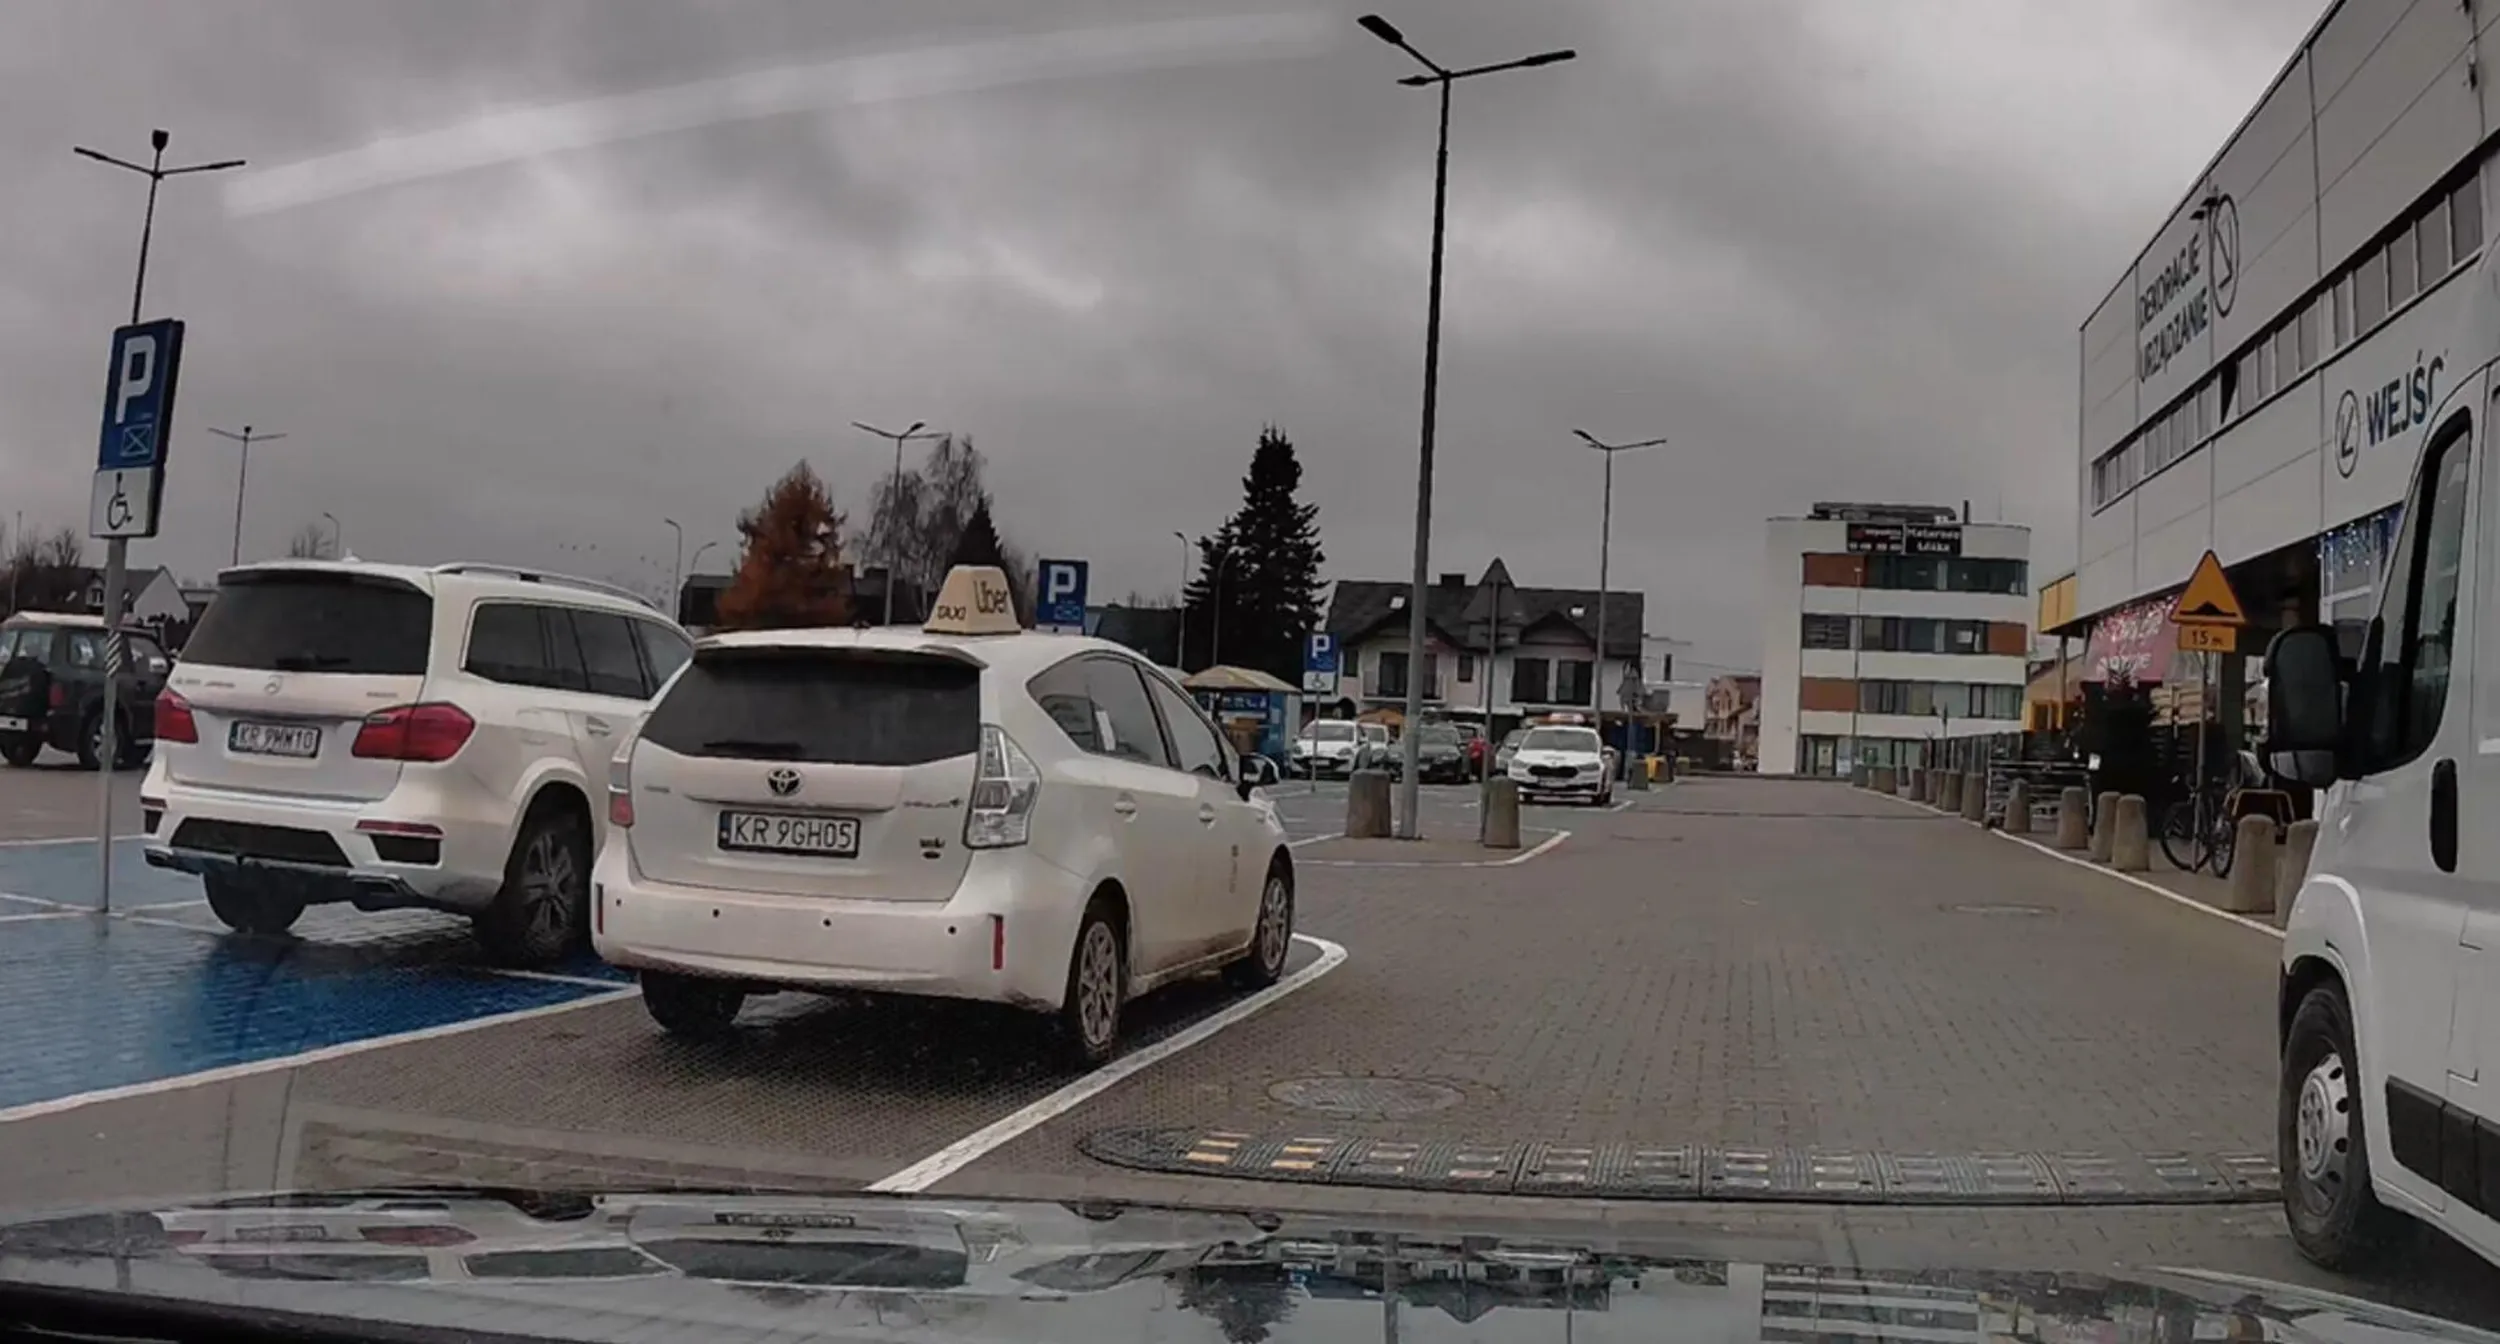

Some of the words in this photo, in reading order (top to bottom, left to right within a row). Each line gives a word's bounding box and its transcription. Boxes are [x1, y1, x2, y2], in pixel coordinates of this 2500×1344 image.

[115, 334, 157, 425] P
[2365, 348, 2448, 448] WEJŚC
[973, 580, 1009, 615] Uber
[1048, 564, 1077, 605] P
[1311, 634, 1331, 659] P
[2191, 630, 2209, 646] 15
[240, 724, 261, 748] KR
[734, 815, 770, 844] KR
[776, 819, 853, 849] 9GH05
